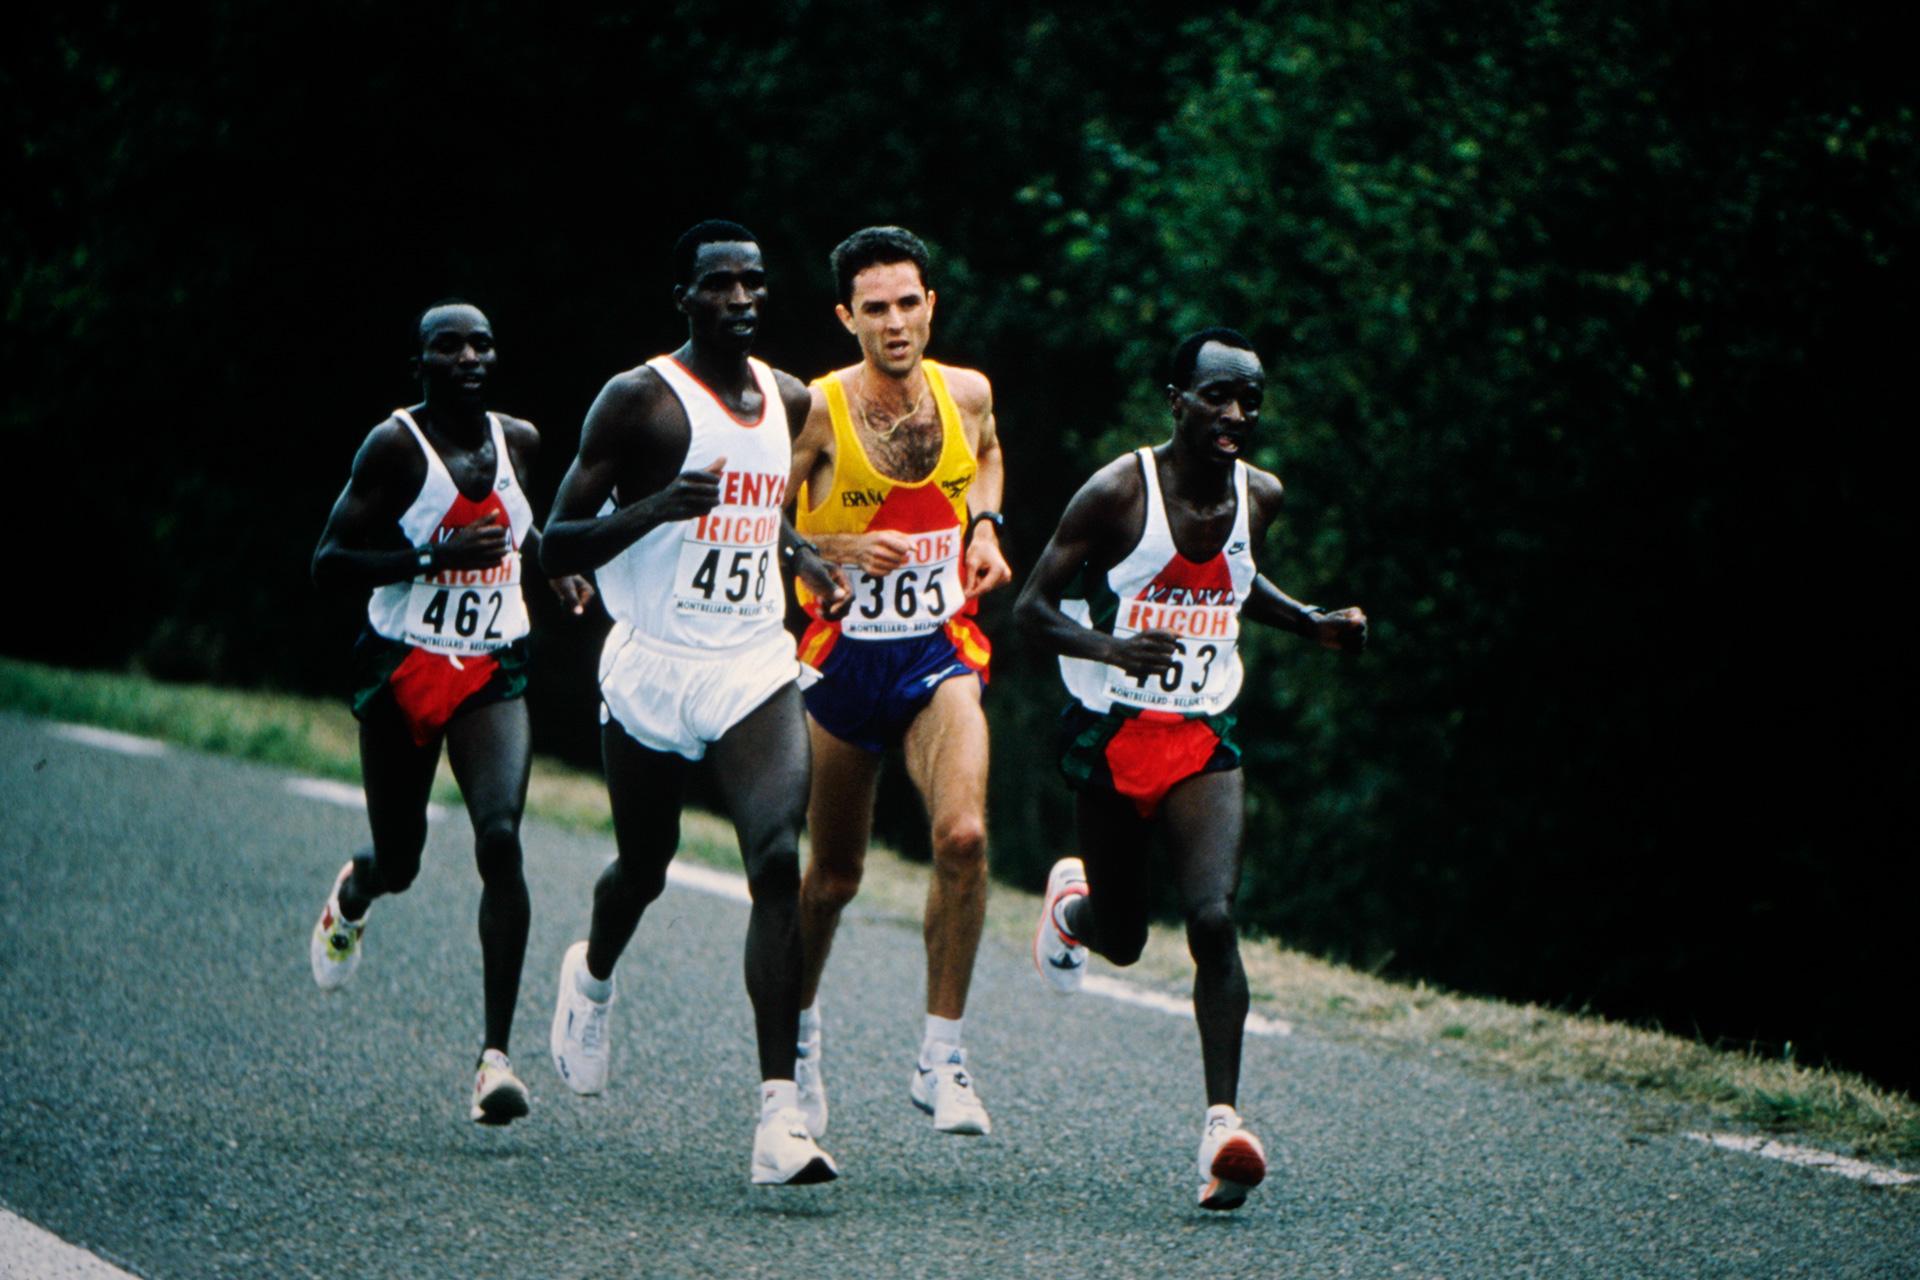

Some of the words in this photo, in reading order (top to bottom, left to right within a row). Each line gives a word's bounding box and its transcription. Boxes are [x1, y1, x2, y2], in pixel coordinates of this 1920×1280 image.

[720, 471, 785, 508] ENYA
[696, 514, 777, 545] RICOH
[692, 548, 769, 603] 458
[860, 567, 946, 619] 365
[422, 589, 504, 640] 462
[1127, 604, 1228, 638] RICOH
